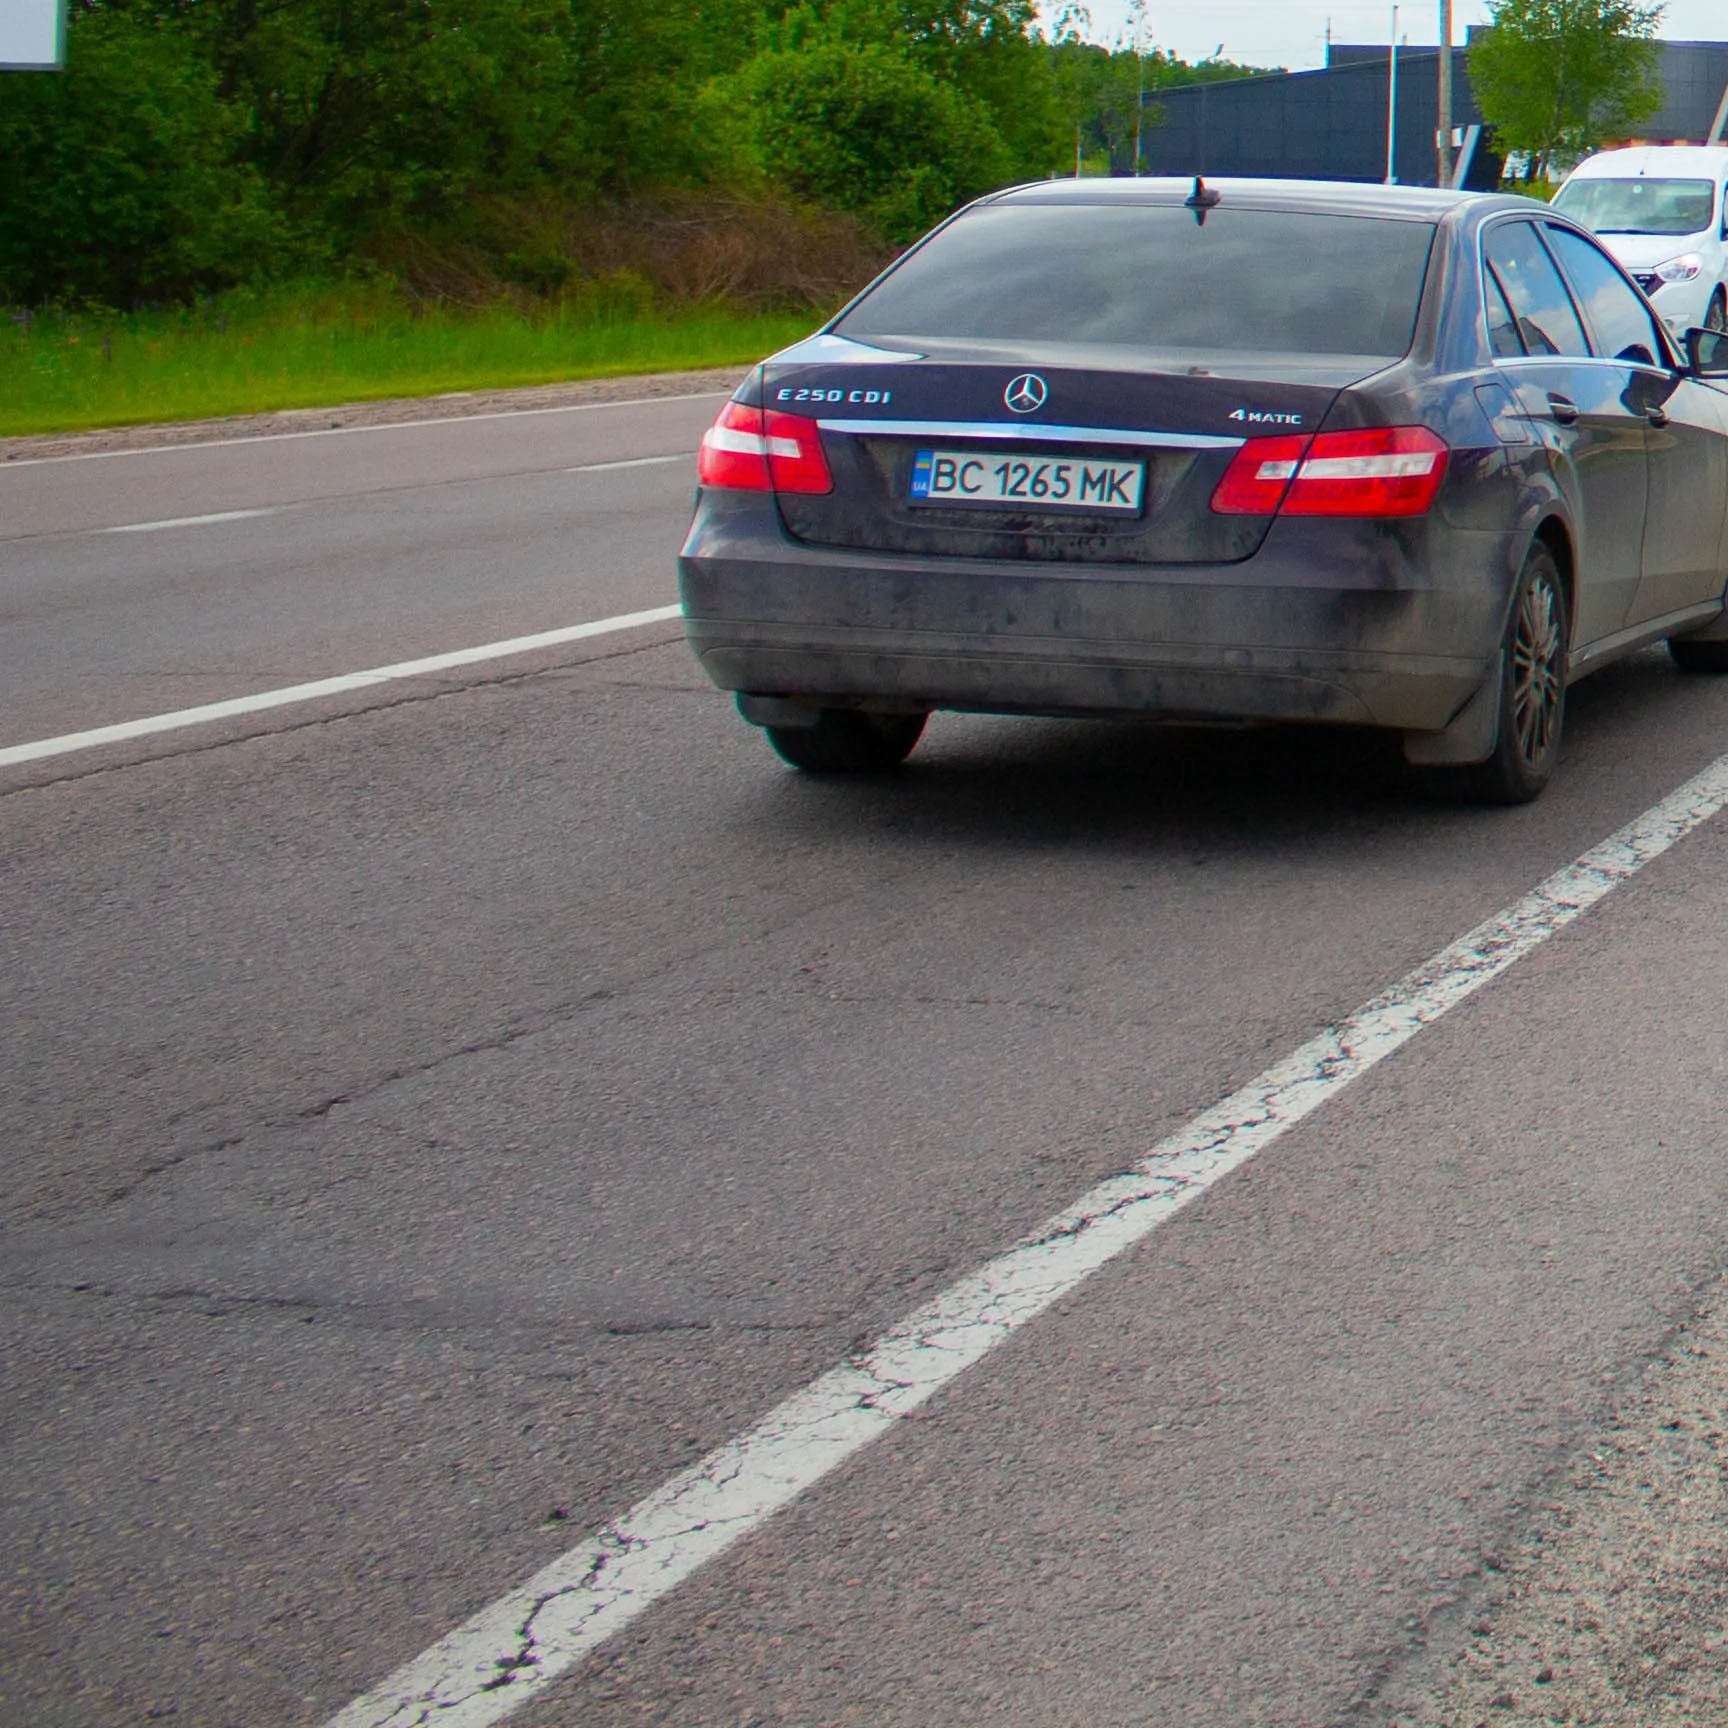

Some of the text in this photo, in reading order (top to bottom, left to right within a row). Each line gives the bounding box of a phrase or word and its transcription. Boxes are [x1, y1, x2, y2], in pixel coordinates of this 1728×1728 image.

[776, 388, 892, 404] E 250 CDI
[931, 458, 1135, 505] BC 1265 MK
